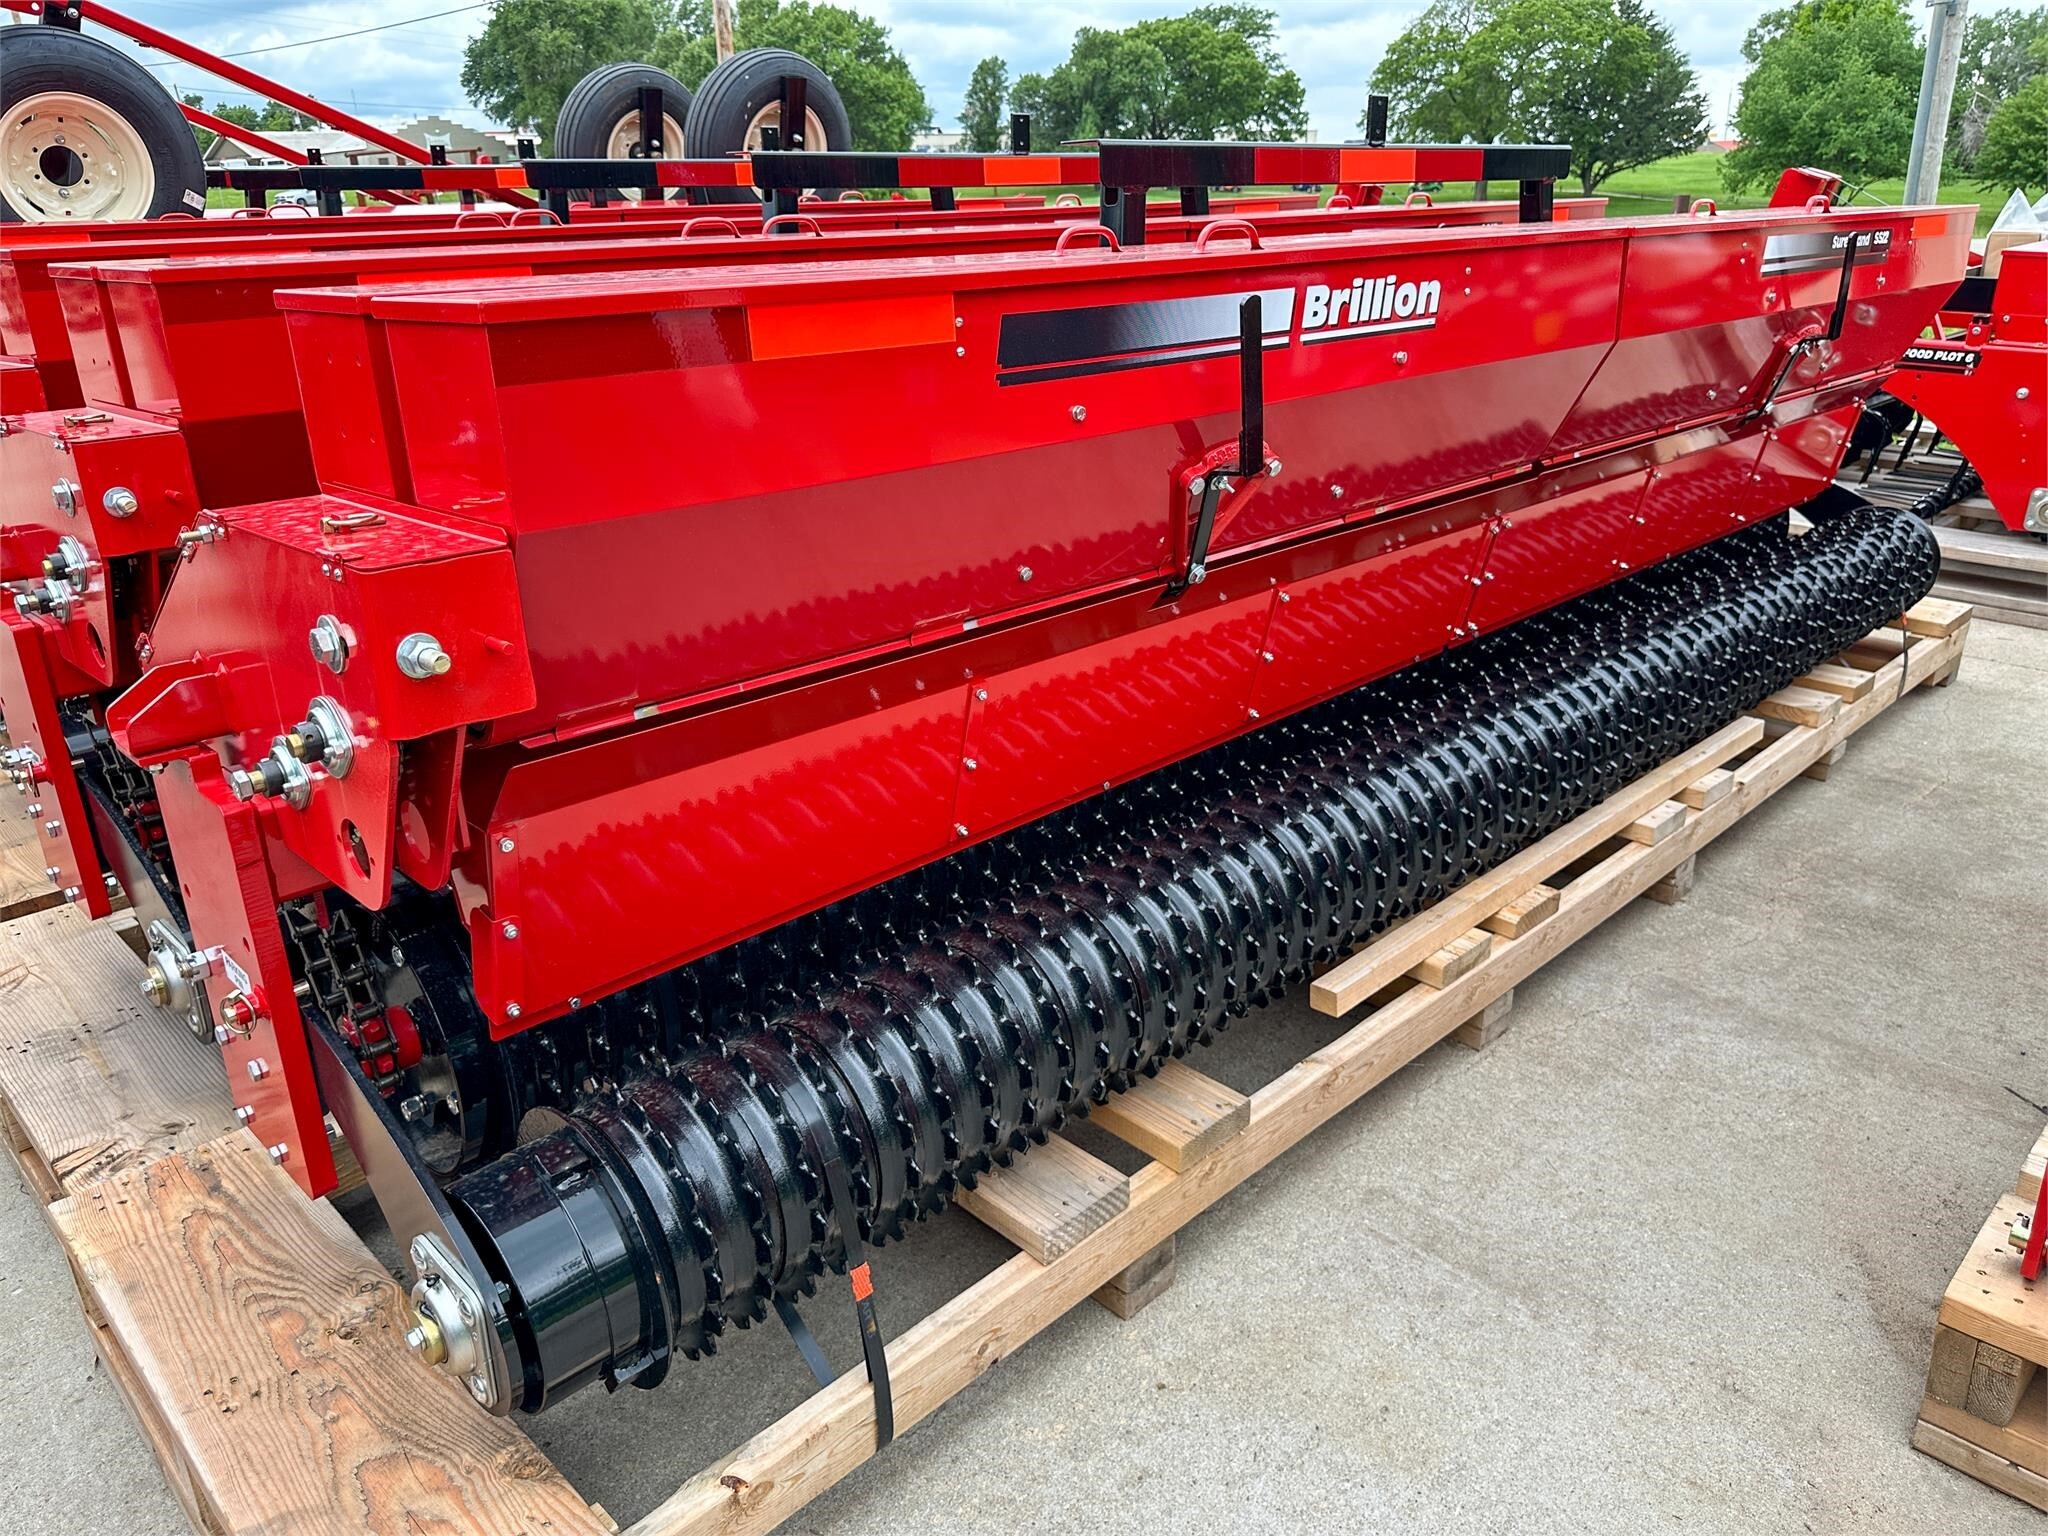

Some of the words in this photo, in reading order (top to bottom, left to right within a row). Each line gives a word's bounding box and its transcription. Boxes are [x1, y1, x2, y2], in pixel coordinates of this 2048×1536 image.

[1832, 232, 1871, 249] Sureand
[1302, 274, 1441, 329] Brillion
[1934, 350, 1965, 362] PLOT
[1965, 353, 1975, 363] 6
